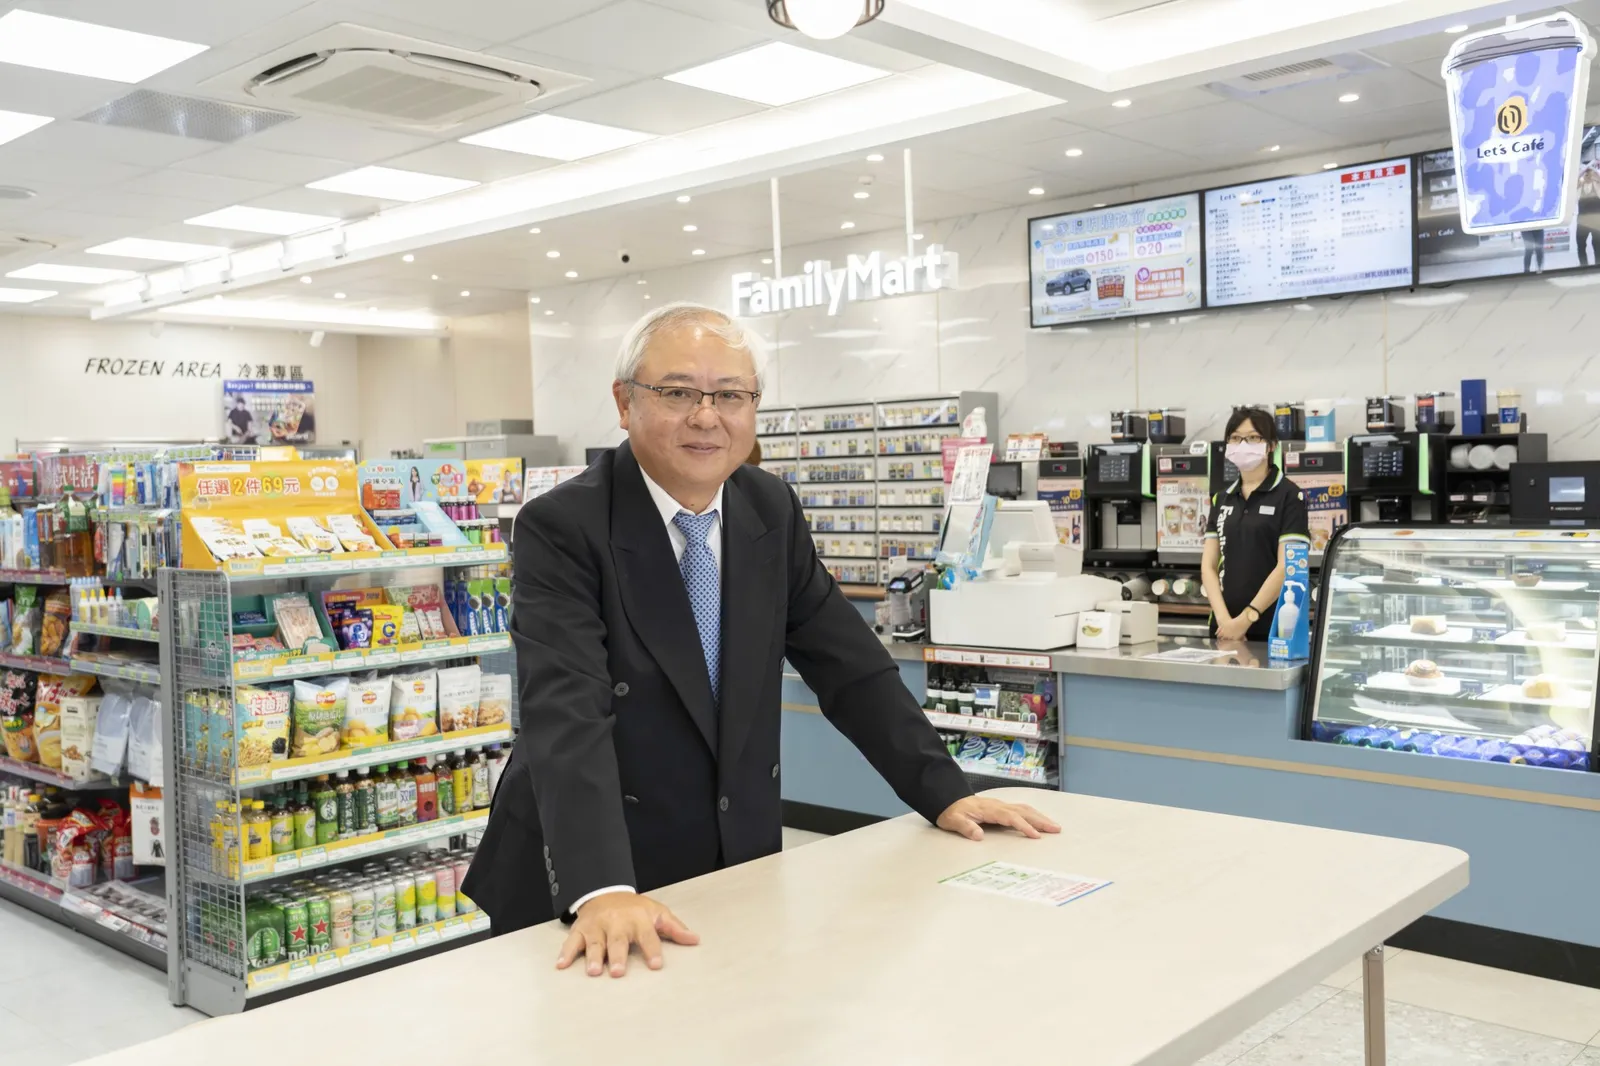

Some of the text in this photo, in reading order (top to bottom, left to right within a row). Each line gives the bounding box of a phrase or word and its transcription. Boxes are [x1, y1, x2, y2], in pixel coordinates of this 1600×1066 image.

[1477, 138, 1545, 159] Let's Café
[732, 243, 943, 316] FamilyMart
[84, 357, 304, 381] FROZEN AREA 冷凍專區
[198, 476, 300, 497] 任選2件69元
